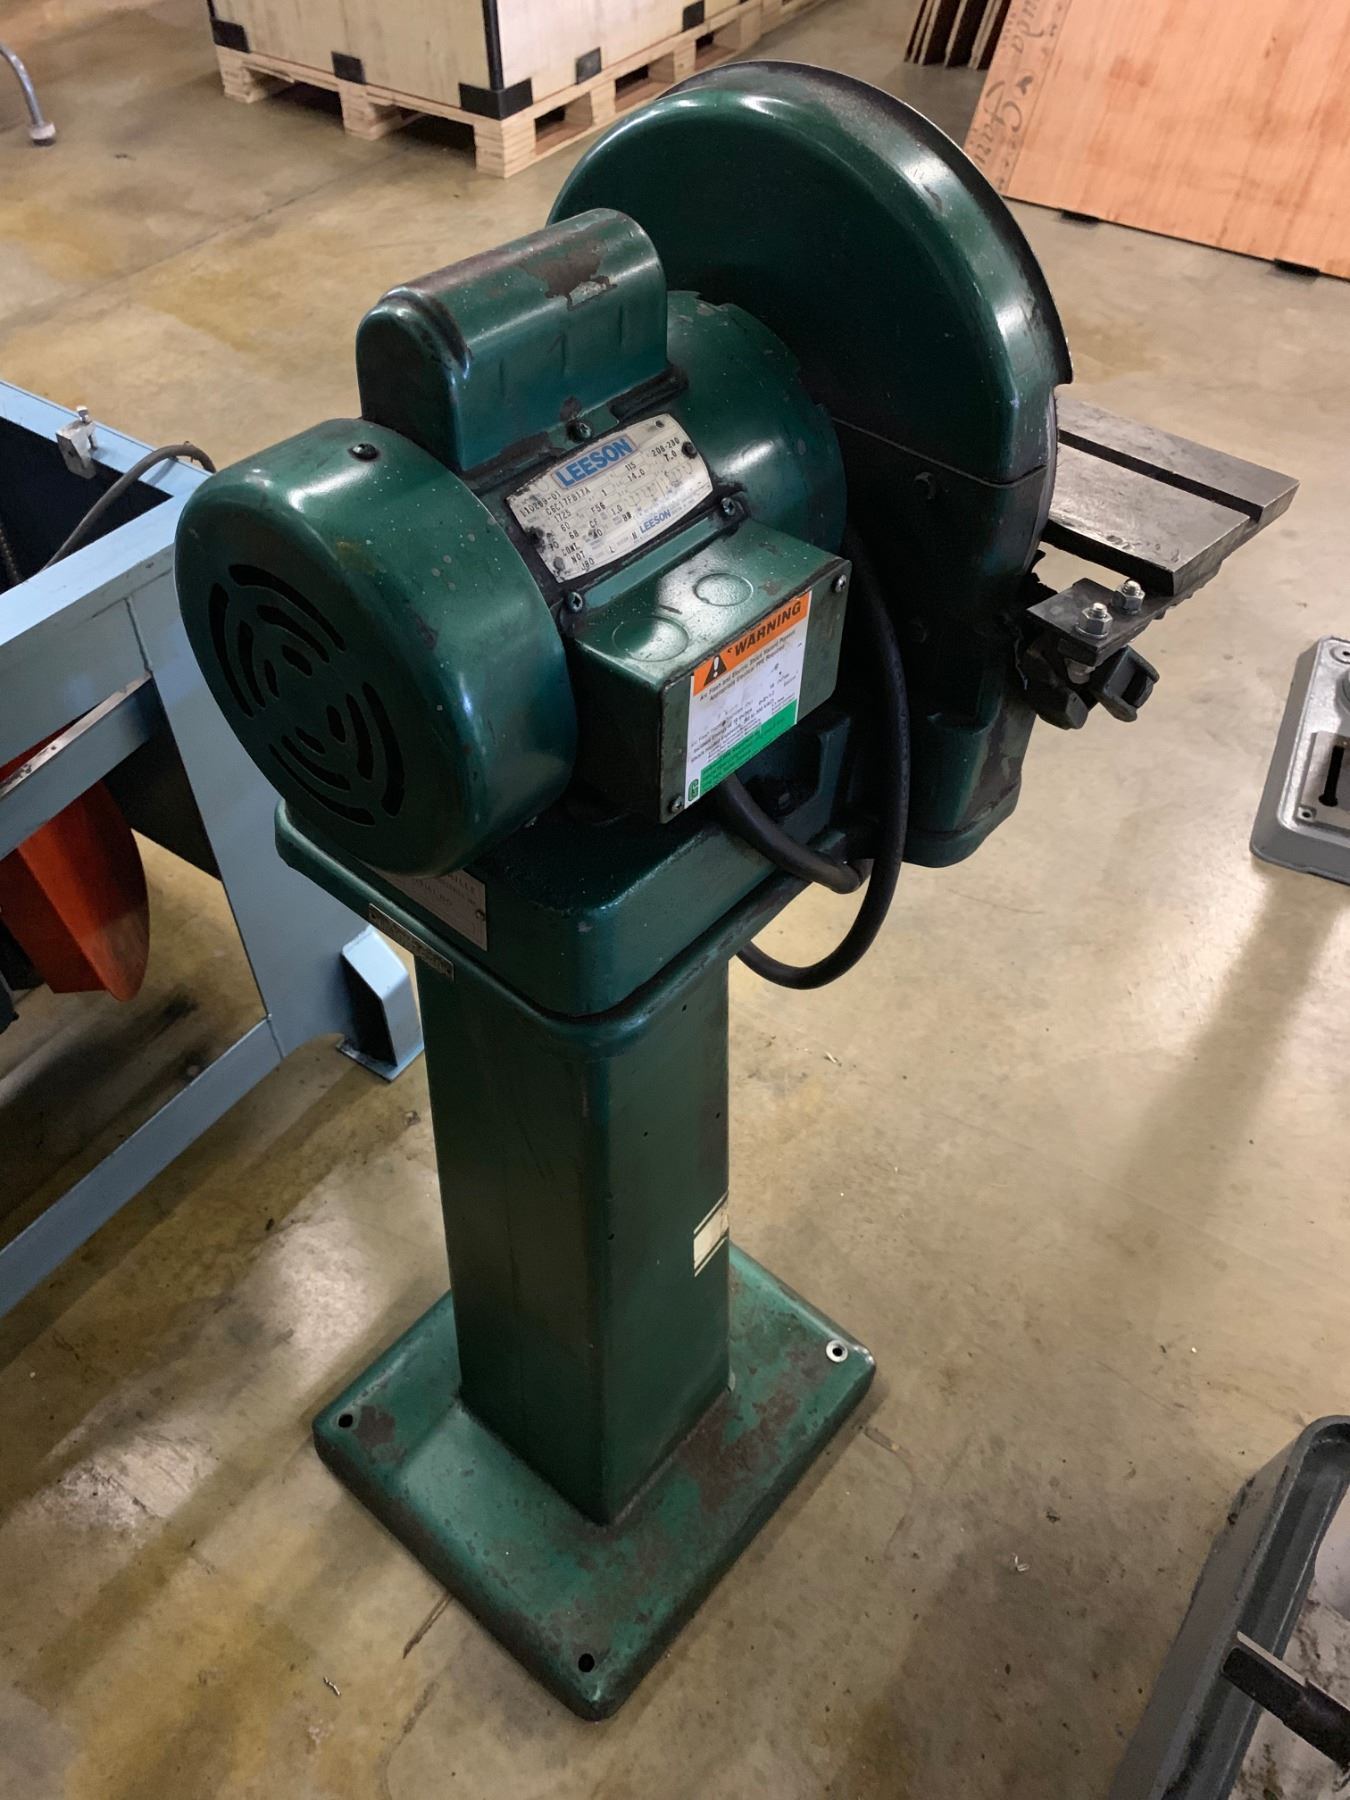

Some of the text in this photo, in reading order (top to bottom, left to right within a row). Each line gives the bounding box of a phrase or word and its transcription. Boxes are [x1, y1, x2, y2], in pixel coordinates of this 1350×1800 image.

[555, 439, 632, 487] LEESON
[640, 508, 671, 533] LEESON
[734, 601, 801, 656] WARNING
